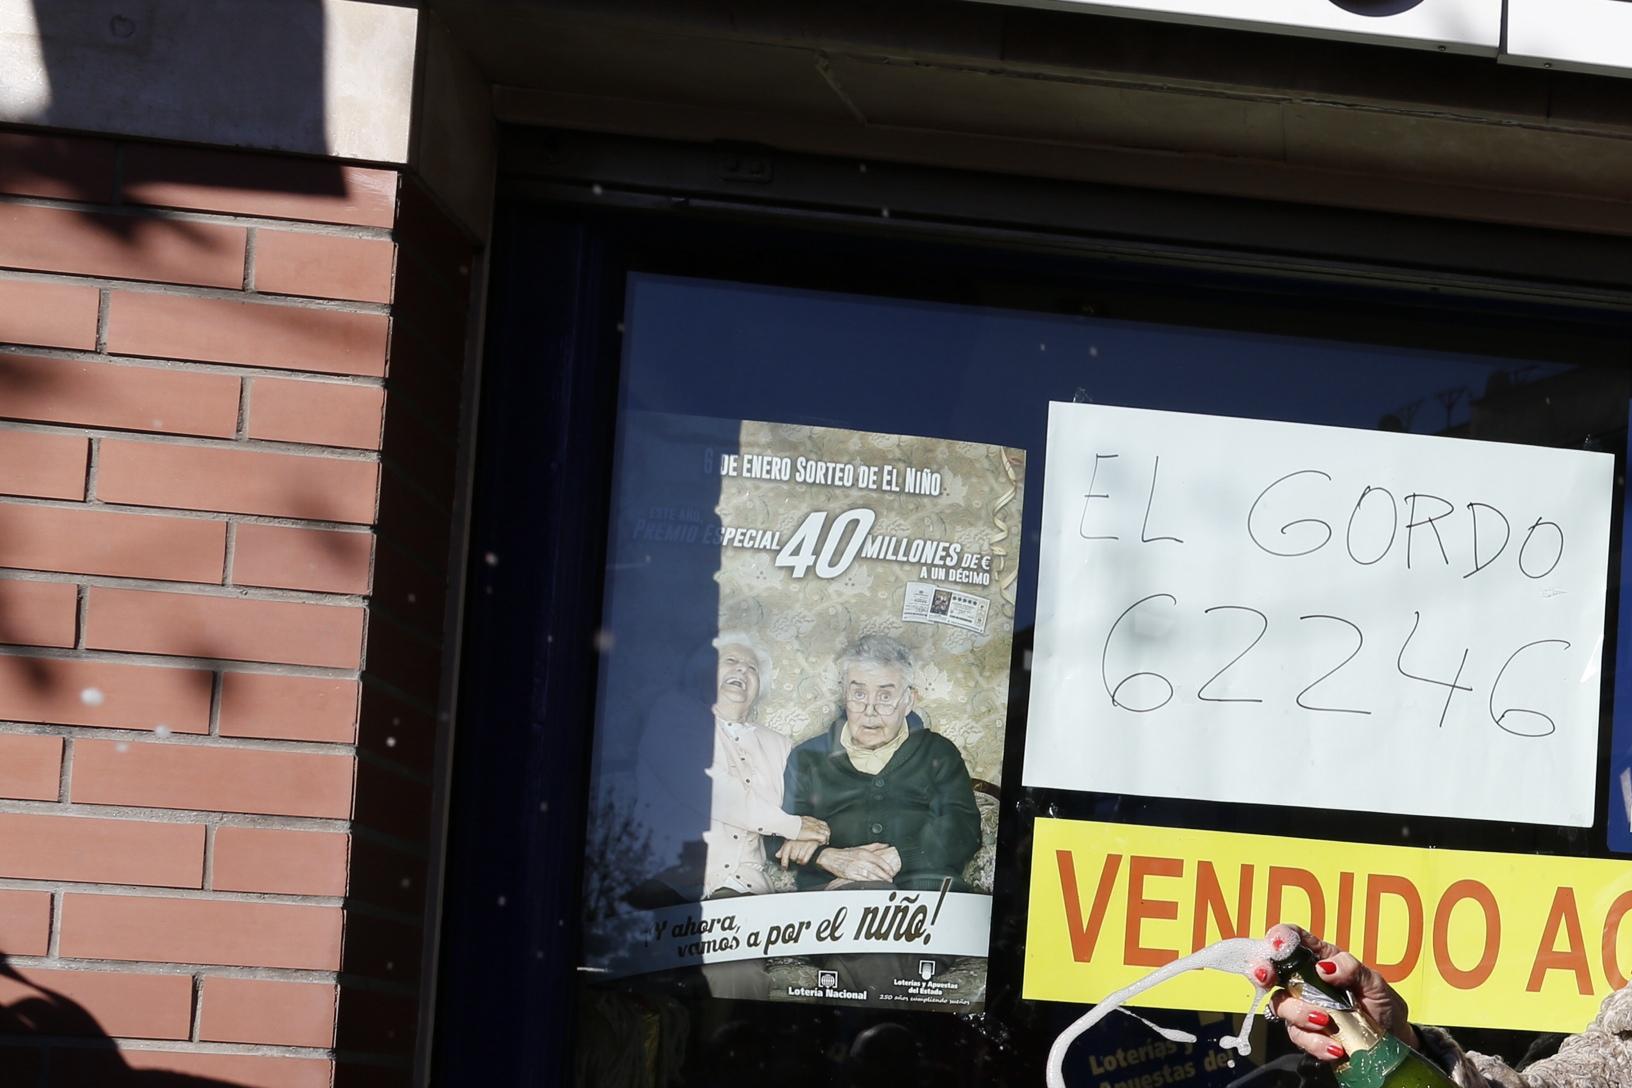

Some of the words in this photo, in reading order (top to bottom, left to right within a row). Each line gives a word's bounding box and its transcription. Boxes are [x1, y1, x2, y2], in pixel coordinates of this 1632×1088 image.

[720, 454, 738, 477] DE
[743, 454, 790, 481] ENERO
[858, 465, 877, 489] DE
[1078, 453, 1183, 544] EL
[1248, 469, 1564, 579] GORDO
[775, 508, 876, 580] 40
[862, 533, 961, 566] MILLONES
[920, 566, 928, 579] A
[931, 567, 945, 580] UN
[949, 566, 990, 586] DÉCIMO
[1101, 593, 1571, 738] 62246
[671, 915, 740, 938] ahora,
[677, 935, 740, 957] vamos
[746, 928, 761, 947] a
[763, 919, 811, 955] por
[815, 906, 848, 942] el
[853, 877, 952, 945] niño!
[1056, 849, 1501, 990] VENDIDO
[826, 988, 868, 1000] Nacional
[920, 987, 943, 995] Estado
